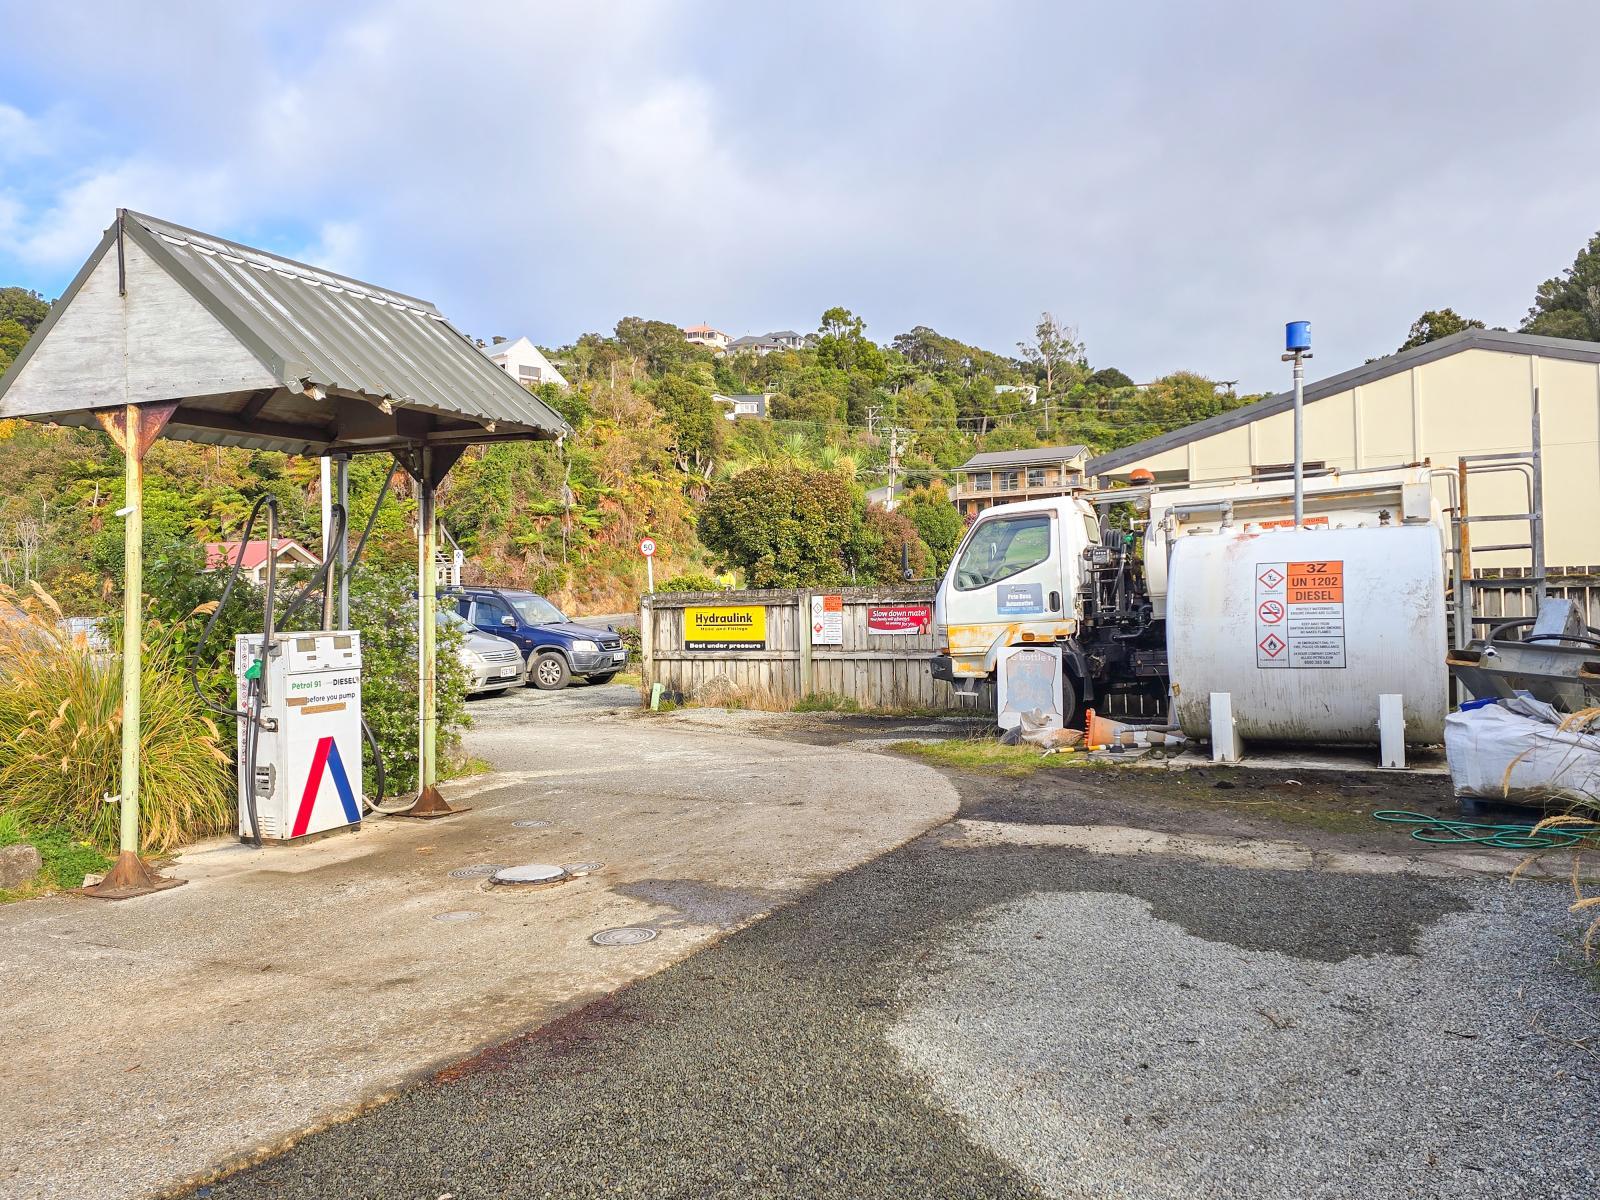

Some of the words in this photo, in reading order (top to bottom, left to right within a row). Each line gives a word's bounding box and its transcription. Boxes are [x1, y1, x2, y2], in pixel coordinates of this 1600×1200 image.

[643, 543, 653, 552] 50
[1306, 563, 1328, 574] 3Z
[1291, 577, 1307, 587] UN
[1311, 576, 1338, 587] 1202
[1295, 590, 1335, 601] DIESEL
[695, 612, 753, 624] Hydraulink
[888, 609, 907, 617] down
[907, 609, 927, 617] mate!
[728, 643, 761, 651] pressure
[1019, 652, 1046, 662] bottle
[292, 681, 313, 690] Petrol
[314, 680, 322, 688] 91
[333, 677, 356, 686] DIESEL
[326, 694, 338, 702] you
[338, 692, 356, 700] pump
